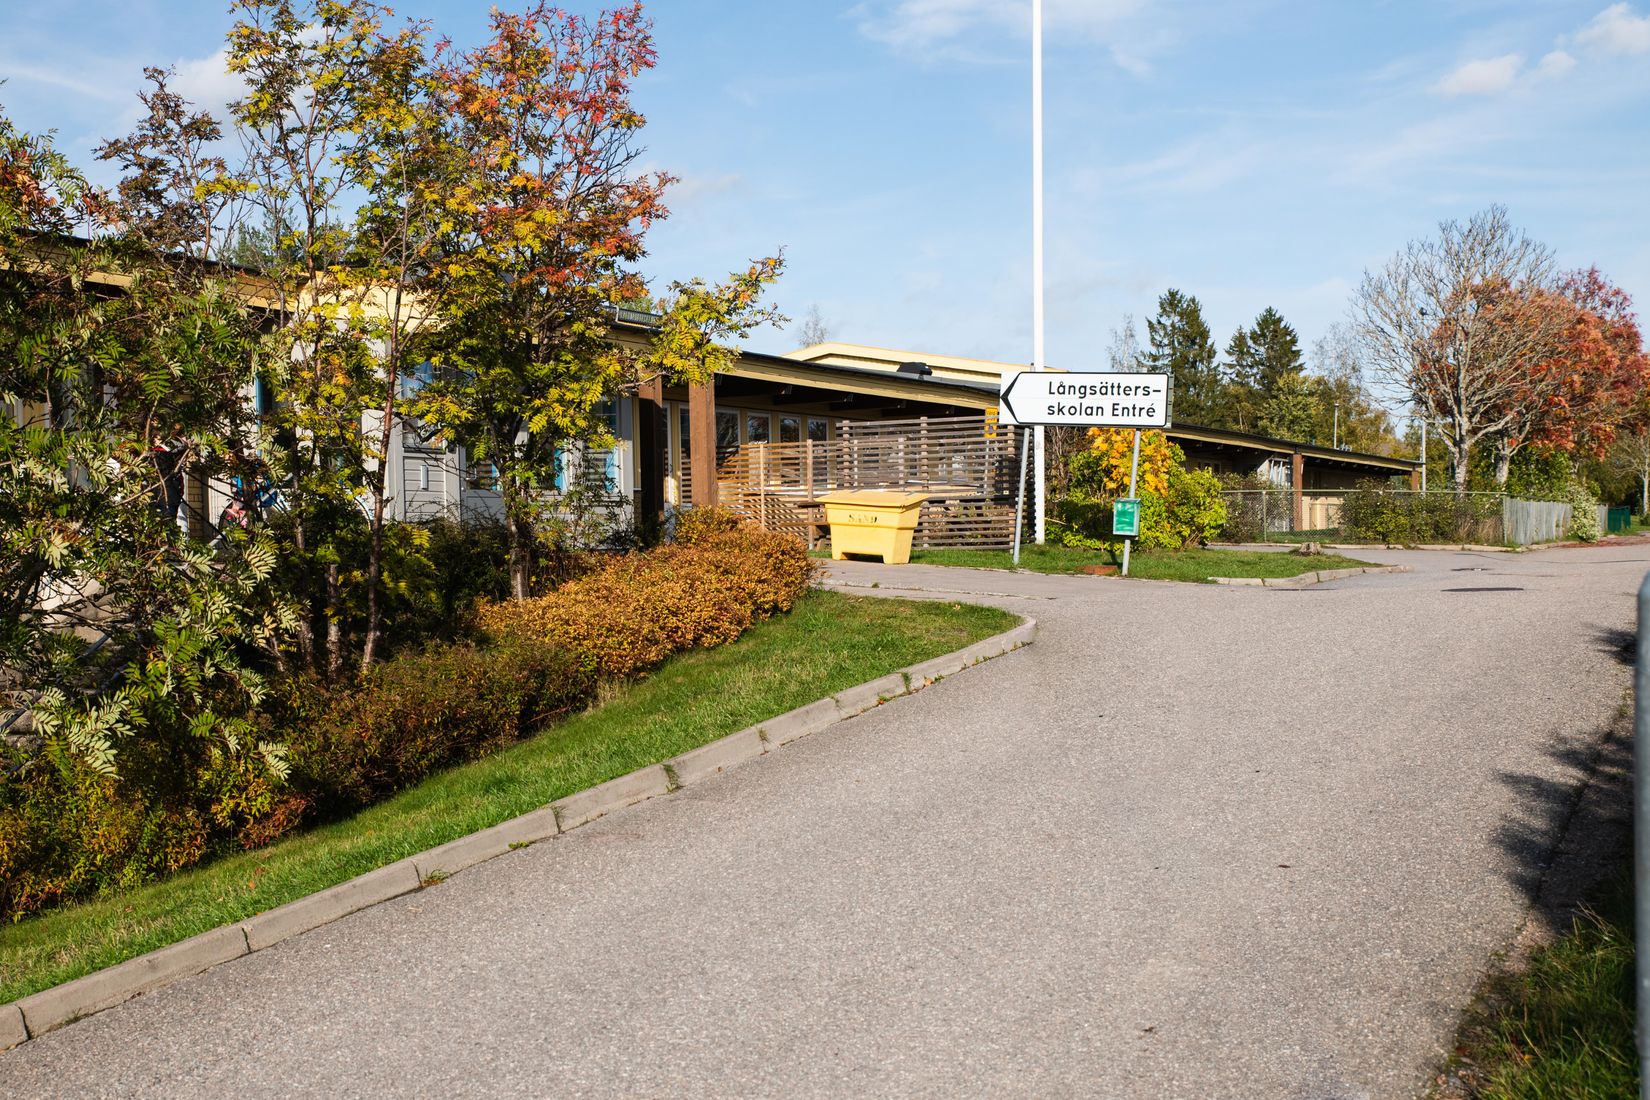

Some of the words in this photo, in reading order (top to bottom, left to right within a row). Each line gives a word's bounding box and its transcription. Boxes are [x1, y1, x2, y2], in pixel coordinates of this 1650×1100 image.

[1048, 381, 1162, 399] Långsätters-
[1047, 402, 1105, 416] skolan
[1111, 403, 1156, 418] Entré
